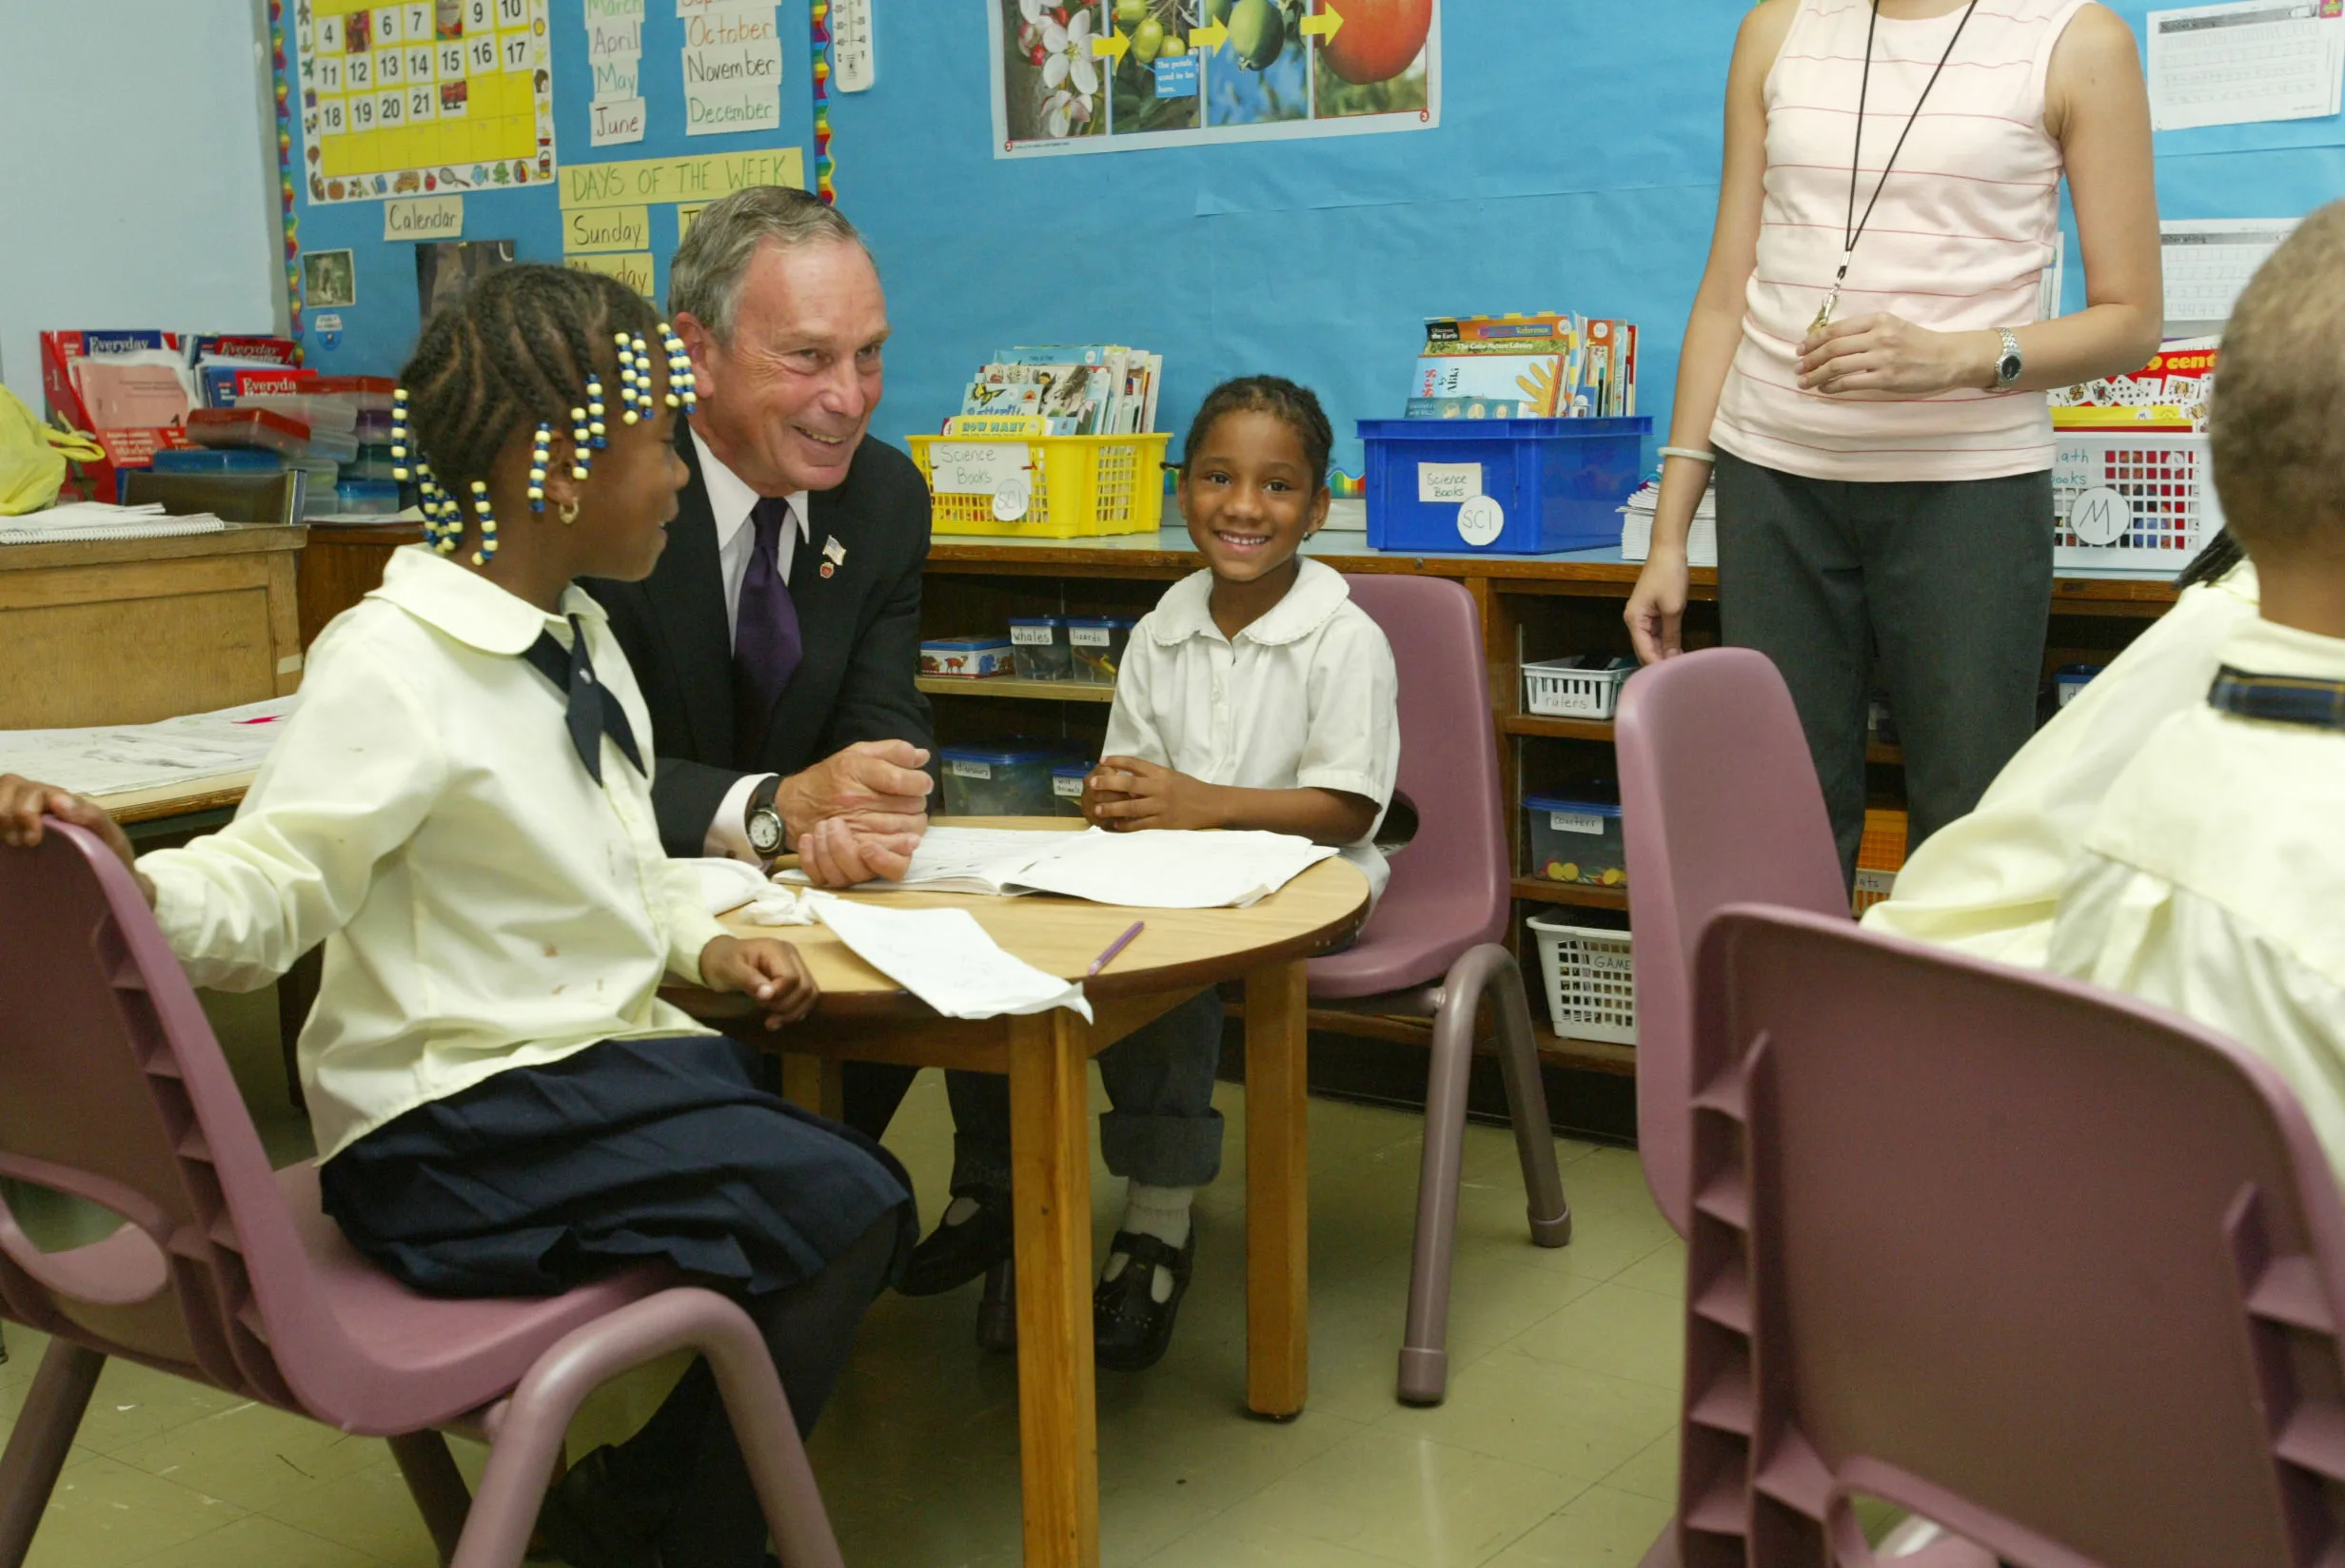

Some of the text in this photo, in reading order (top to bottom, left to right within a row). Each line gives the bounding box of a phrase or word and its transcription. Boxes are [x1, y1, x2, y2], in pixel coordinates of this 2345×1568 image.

[324, 0, 522, 44] 4 6 7 9 10
[689, 15, 774, 48] October
[593, 21, 640, 57] April
[321, 42, 525, 86] 11 12 13 14 15 16 17
[687, 49, 776, 83] November
[596, 63, 636, 99] May
[324, 107, 342, 128] 18
[353, 103, 372, 124] 19
[382, 99, 401, 120] 20
[413, 93, 430, 115] 21
[595, 107, 640, 137] June
[689, 95, 774, 123] December
[572, 155, 787, 203] DAYS OF THE WEEK
[389, 204, 458, 231] Calendar
[574, 211, 641, 245] Sunday
[89, 336, 149, 355] Everyday
[221, 342, 280, 356] Everyday
[244, 378, 297, 395] Everyda
[1447, 367, 1459, 392] Aliki
[940, 444, 997, 463] Science
[2056, 448, 2089, 464] ath
[956, 465, 993, 486] Books
[1428, 473, 1468, 486] Science
[995, 488, 1023, 511] SCI
[1433, 485, 1465, 498] Books
[1462, 509, 1493, 531] SCI
[2079, 499, 2110, 536] M
[1013, 629, 1050, 643] whales
[1546, 695, 1588, 710] rulers
